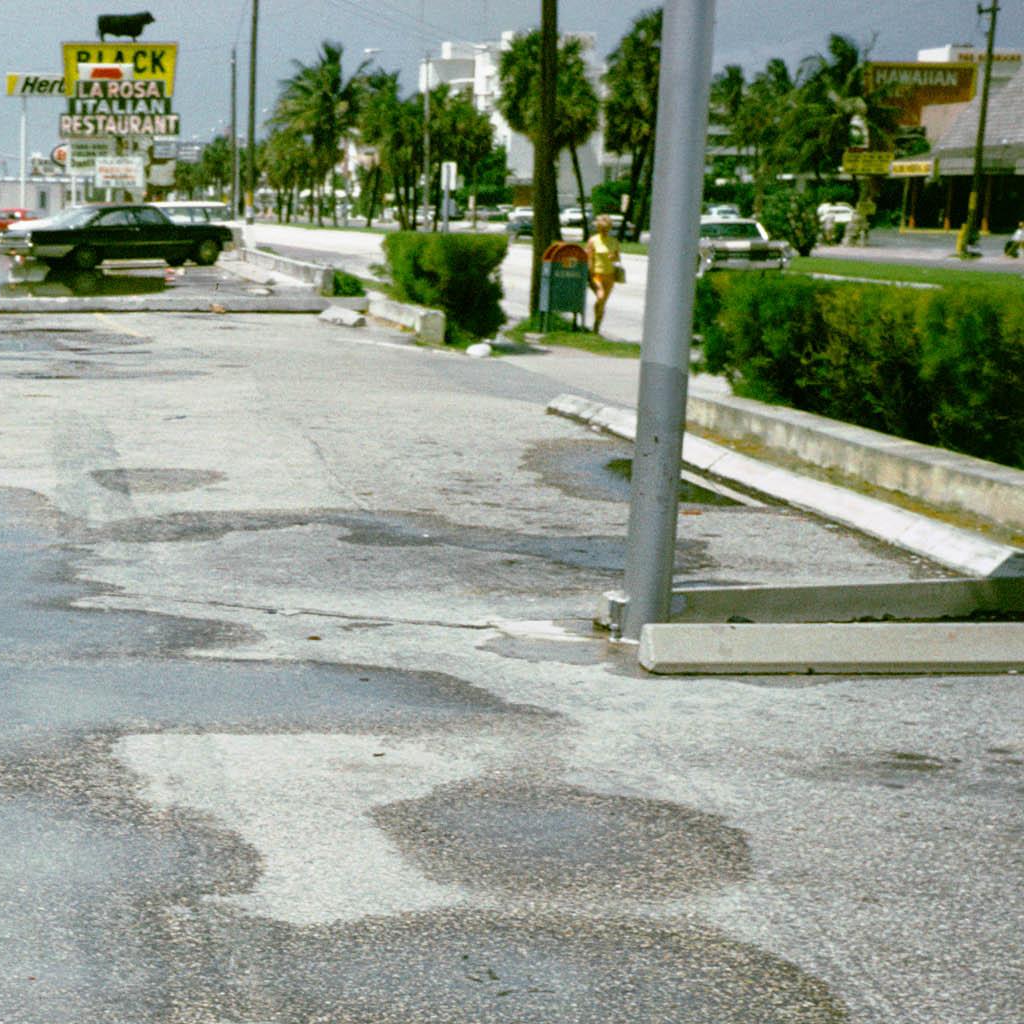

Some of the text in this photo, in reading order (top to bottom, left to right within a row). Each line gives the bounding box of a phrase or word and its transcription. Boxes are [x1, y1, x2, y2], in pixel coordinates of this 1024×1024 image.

[21, 76, 66, 94] Hert
[875, 68, 958, 86] HAWAIIAN
[78, 81, 161, 98] LA ROSA
[74, 98, 166, 114] ITALIAN
[61, 115, 180, 135] RESTAURANT
